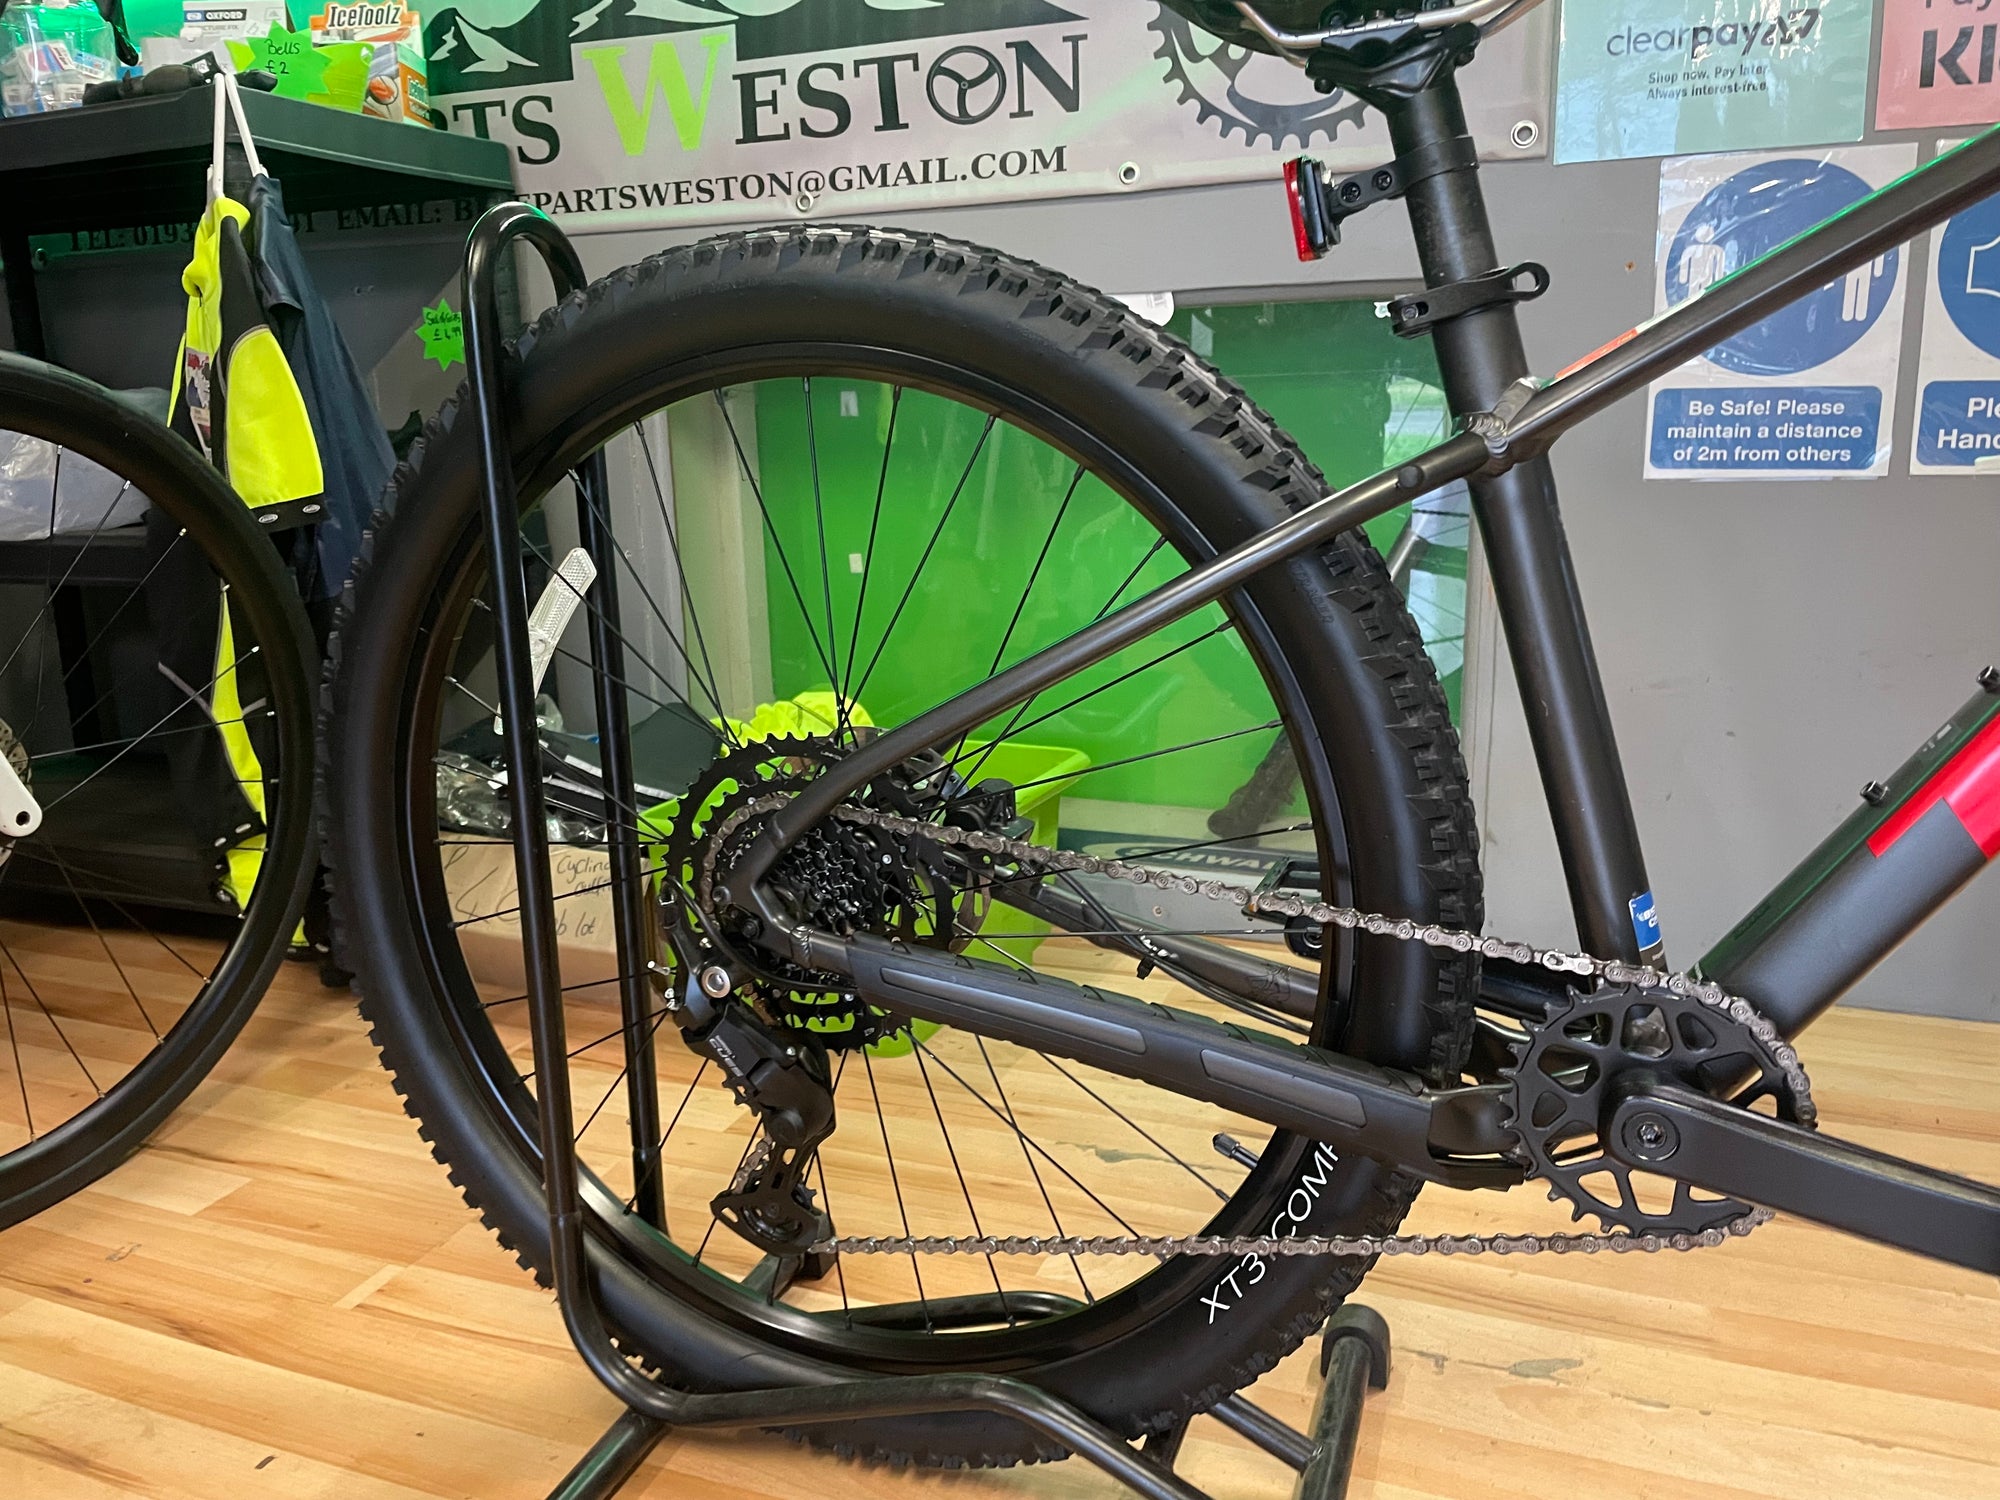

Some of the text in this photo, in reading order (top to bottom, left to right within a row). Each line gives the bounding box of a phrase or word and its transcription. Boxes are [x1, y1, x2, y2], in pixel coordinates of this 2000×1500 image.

[206, 11, 243, 20] OXFORD
[328, 4, 401, 27] IceToolz
[1607, 21, 1762, 60] clearpay
[1715, 66, 1736, 79] Pay
[1648, 84, 1688, 99] Always
[430, 95, 560, 164] TS
[336, 200, 442, 230] EMAIL:
[1689, 399, 1845, 416] Be Safe! Please
[1667, 422, 1863, 439] maintain a distance
[1673, 446, 1851, 462] of 2m from others
[1200, 1251, 1266, 1324] XT3
